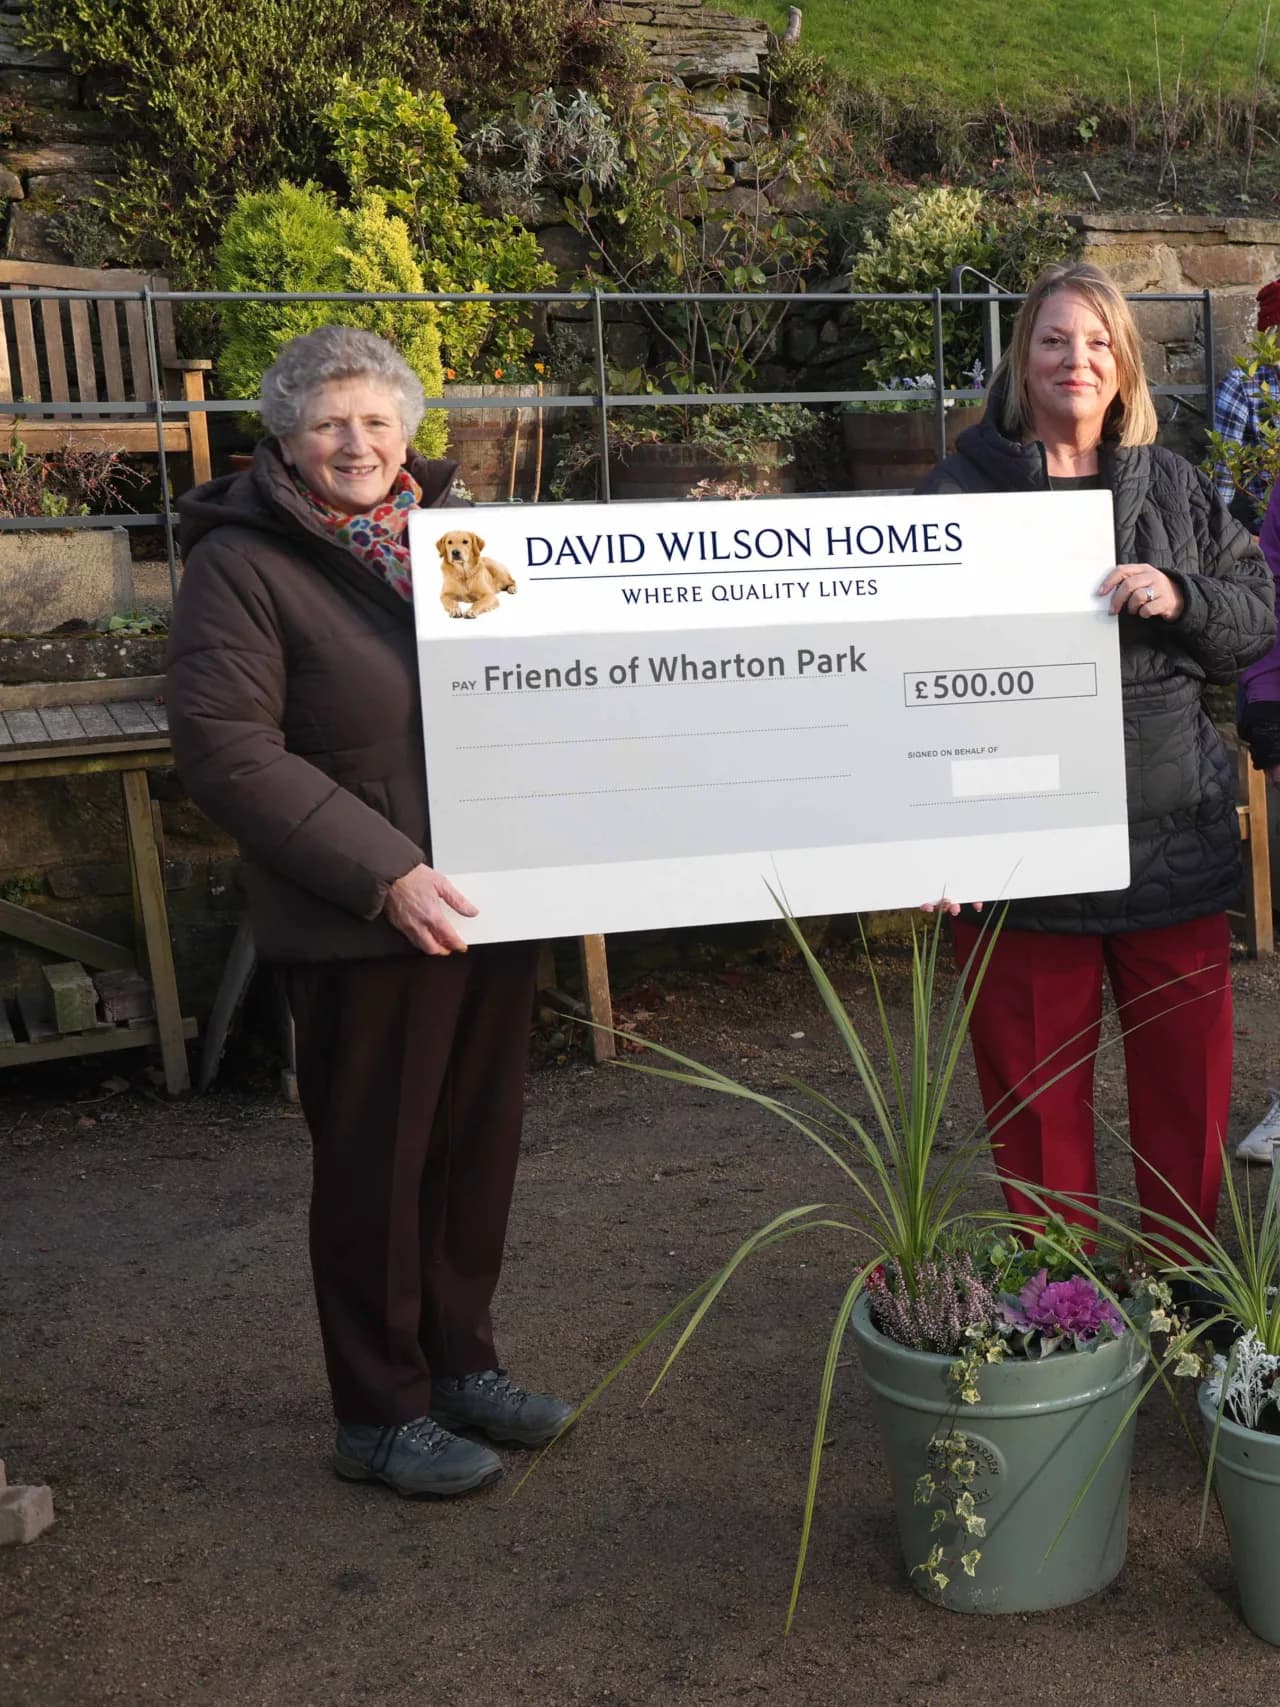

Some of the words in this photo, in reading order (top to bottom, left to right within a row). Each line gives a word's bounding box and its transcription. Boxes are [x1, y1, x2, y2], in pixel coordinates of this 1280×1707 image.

[525, 533, 646, 567] DAVID
[657, 527, 811, 562] WILSON
[826, 522, 963, 556] HOMES
[621, 585, 704, 605] WHERE
[711, 581, 810, 602] QUALITY
[819, 578, 879, 598] LIVES
[452, 680, 477, 691] PAY
[484, 660, 599, 692] Friends
[608, 656, 639, 686] of
[648, 652, 785, 682] Wharton
[797, 645, 868, 675] Park
[907, 750, 938, 759] SIGNED
[954, 747, 986, 756] BEHALF
[988, 746, 999, 754] OF
[966, 1440, 999, 1475] GARDEN
